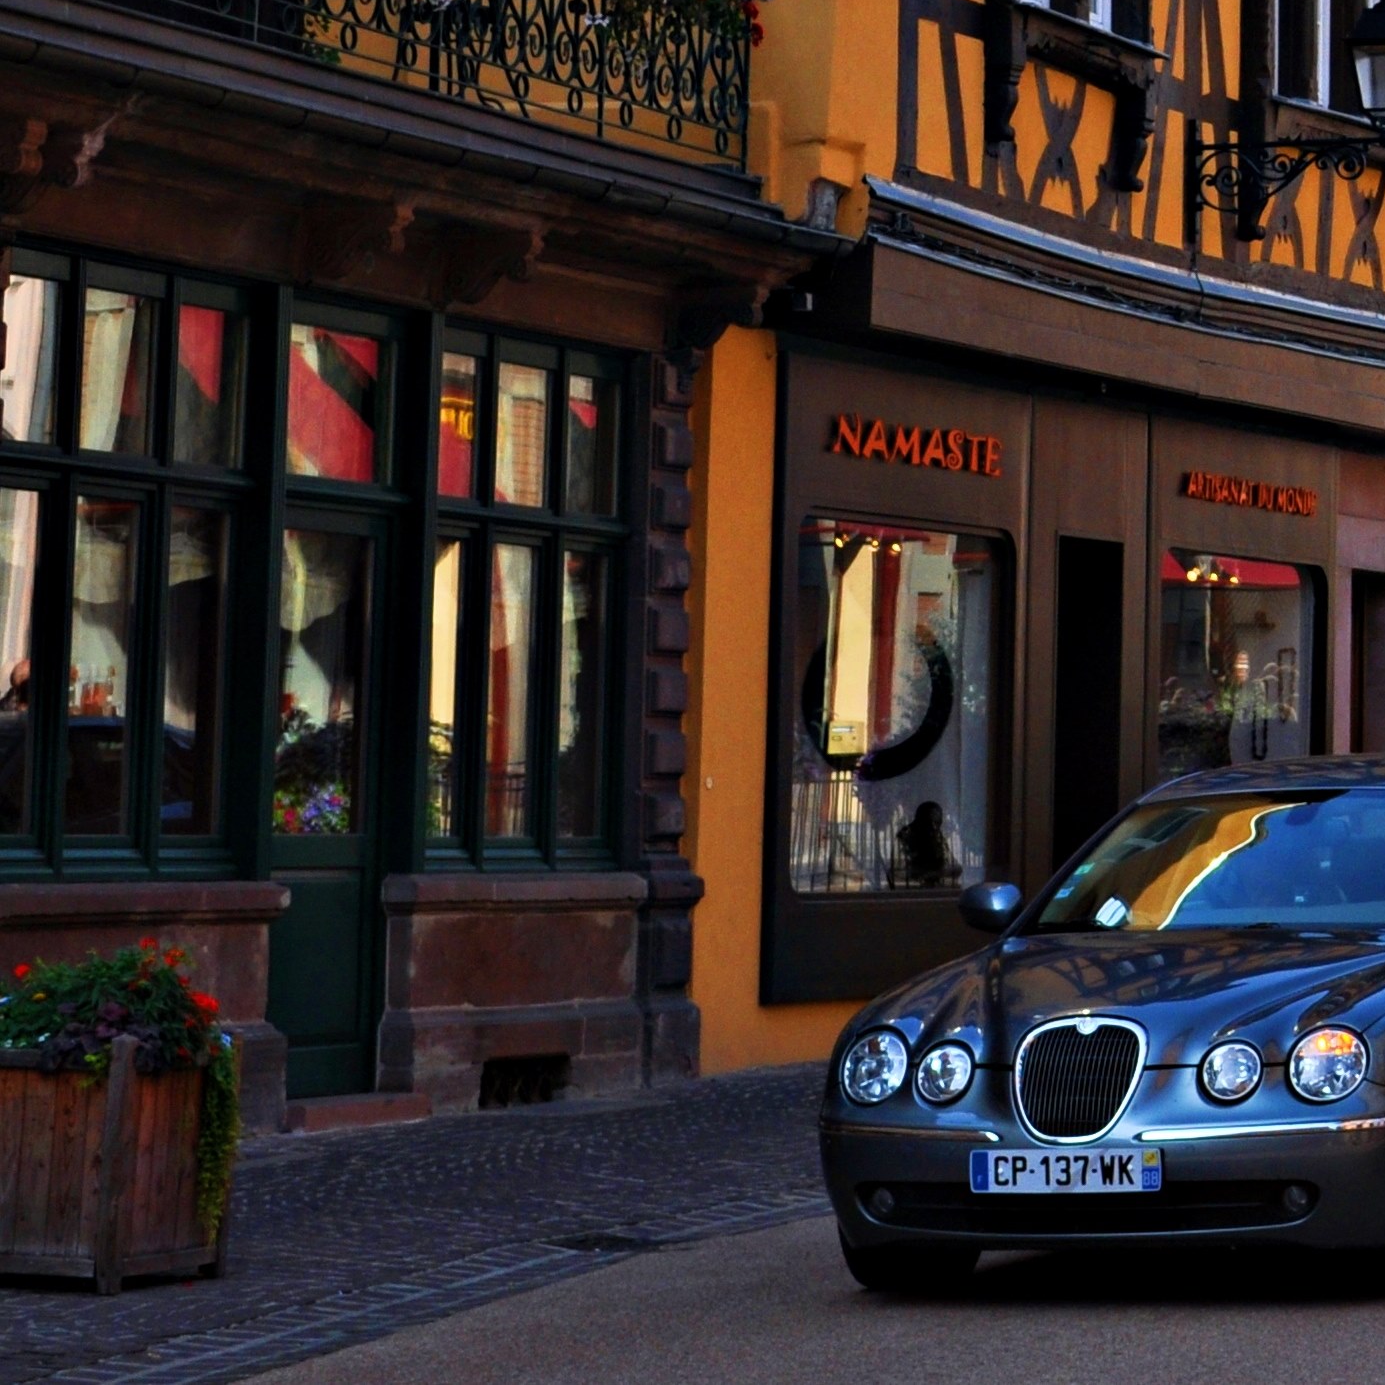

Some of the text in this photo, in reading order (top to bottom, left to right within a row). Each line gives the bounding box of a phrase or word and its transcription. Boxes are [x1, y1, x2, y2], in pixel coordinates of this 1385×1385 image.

[832, 413, 1003, 477] NAMASTE
[1187, 470, 1317, 517] ARTISANAT DU MONDE
[994, 1155, 1134, 1186] CP-137-WK
